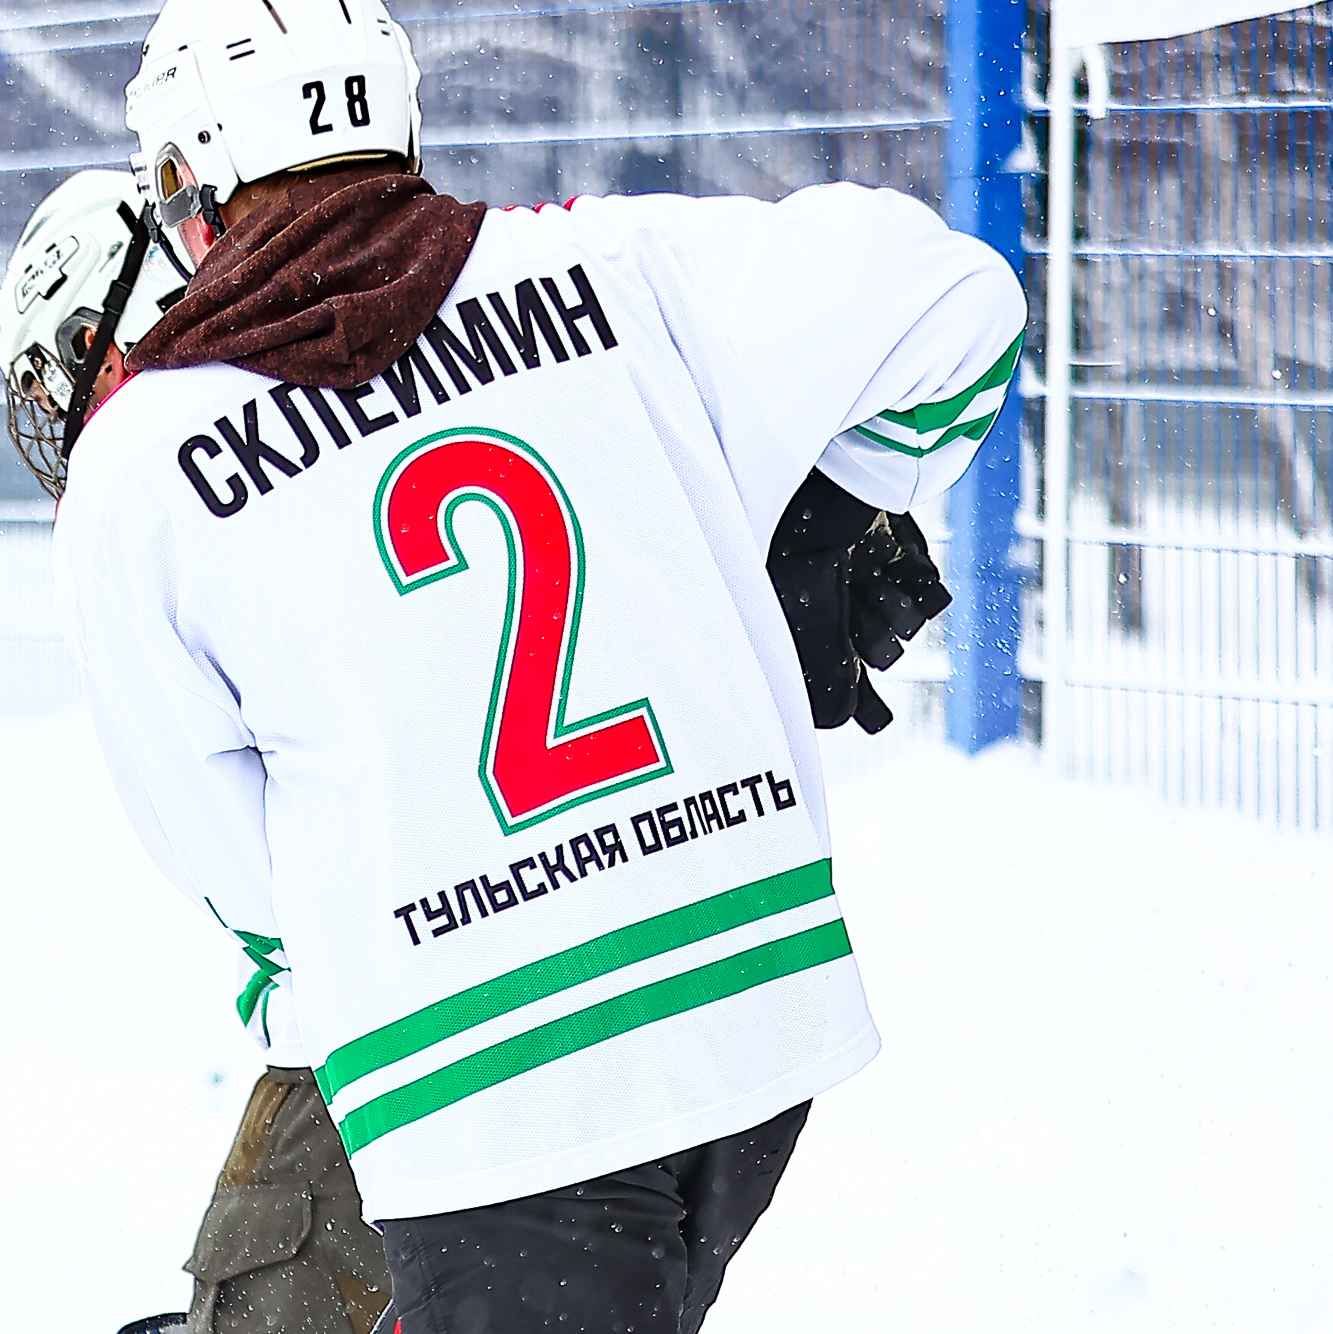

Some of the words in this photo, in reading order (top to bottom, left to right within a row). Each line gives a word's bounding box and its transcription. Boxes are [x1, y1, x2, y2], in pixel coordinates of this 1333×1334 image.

[301, 74, 371, 136] 28
[372, 426, 674, 837] 2
[393, 822, 629, 946] ТУЛЬСКАЯ
[630, 770, 797, 857] ОБЛАСТЬ
